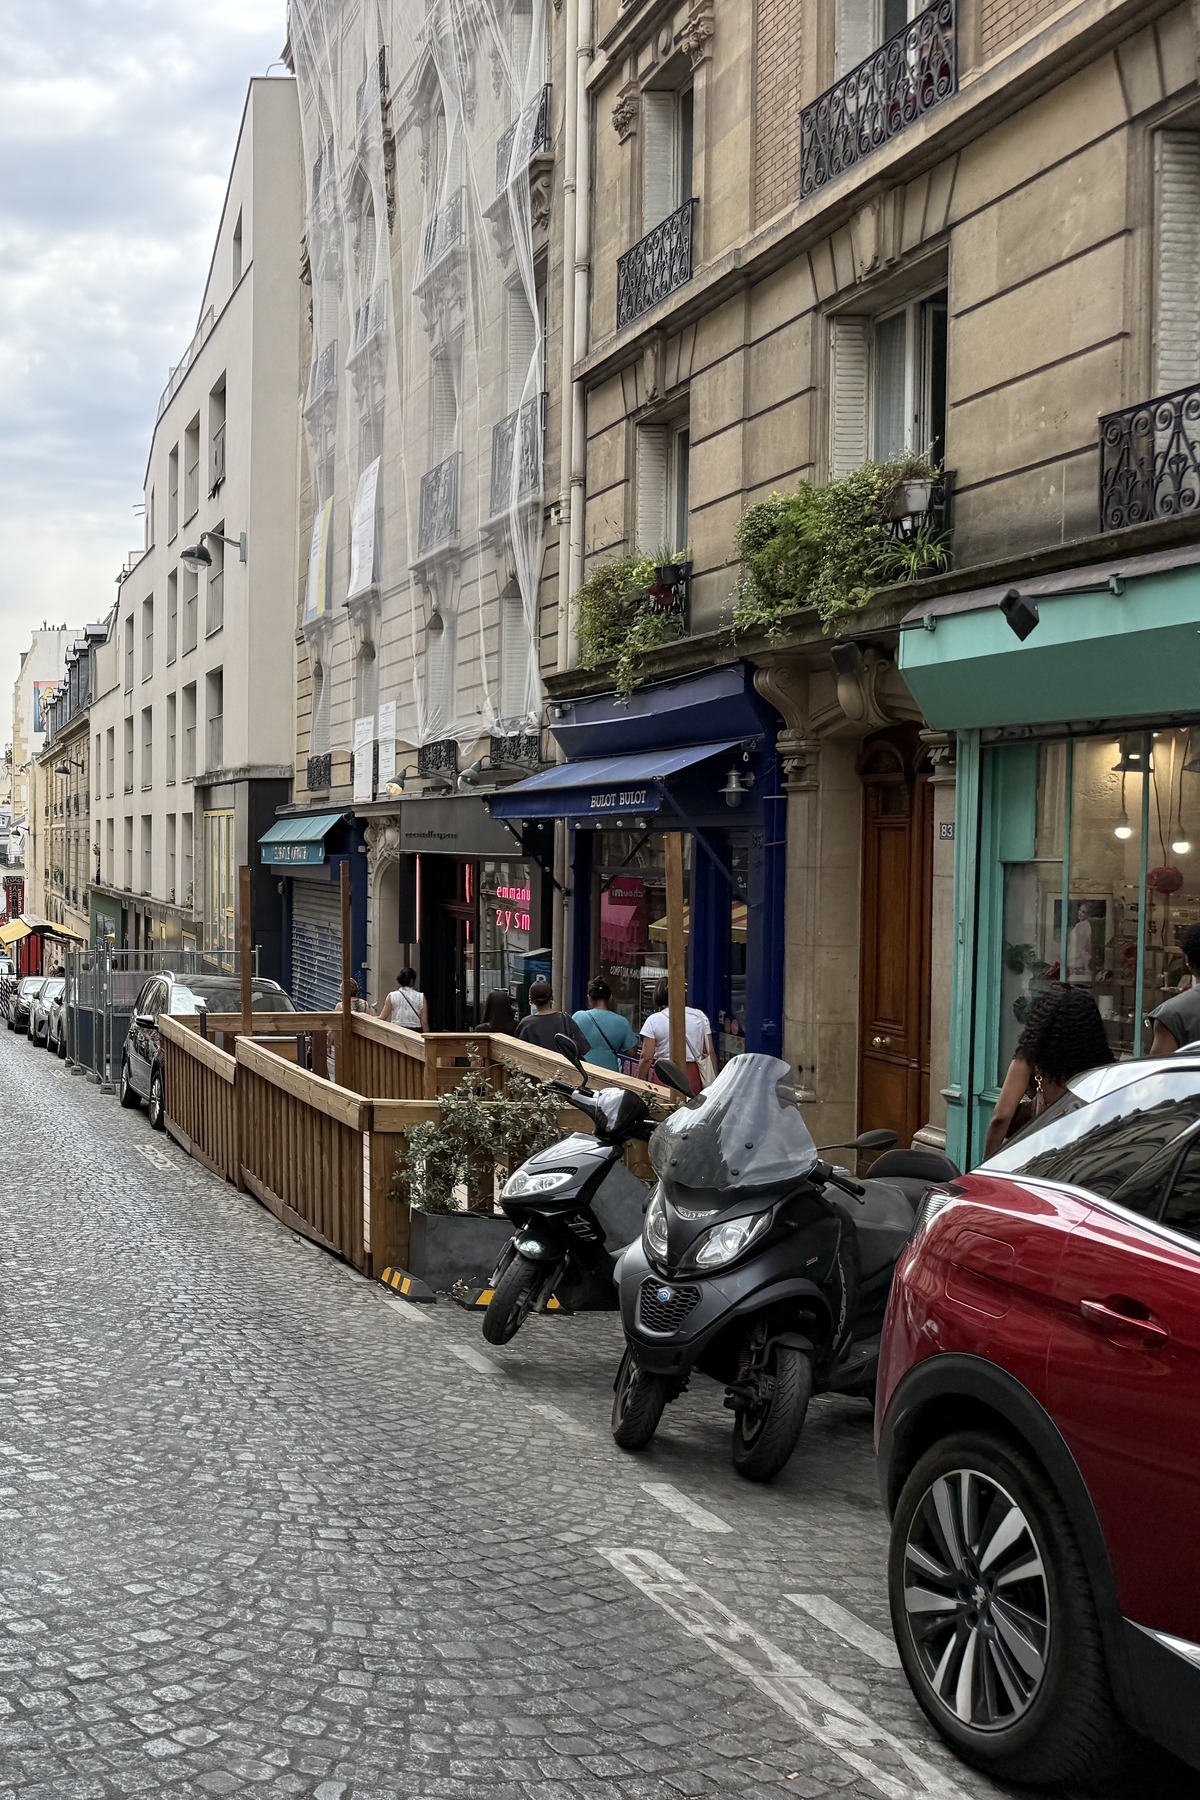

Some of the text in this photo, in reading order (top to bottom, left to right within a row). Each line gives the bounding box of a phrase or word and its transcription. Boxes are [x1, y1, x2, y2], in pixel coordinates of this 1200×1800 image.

[590, 790, 647, 808] BULOT BULOT
[941, 824, 953, 838] 83
